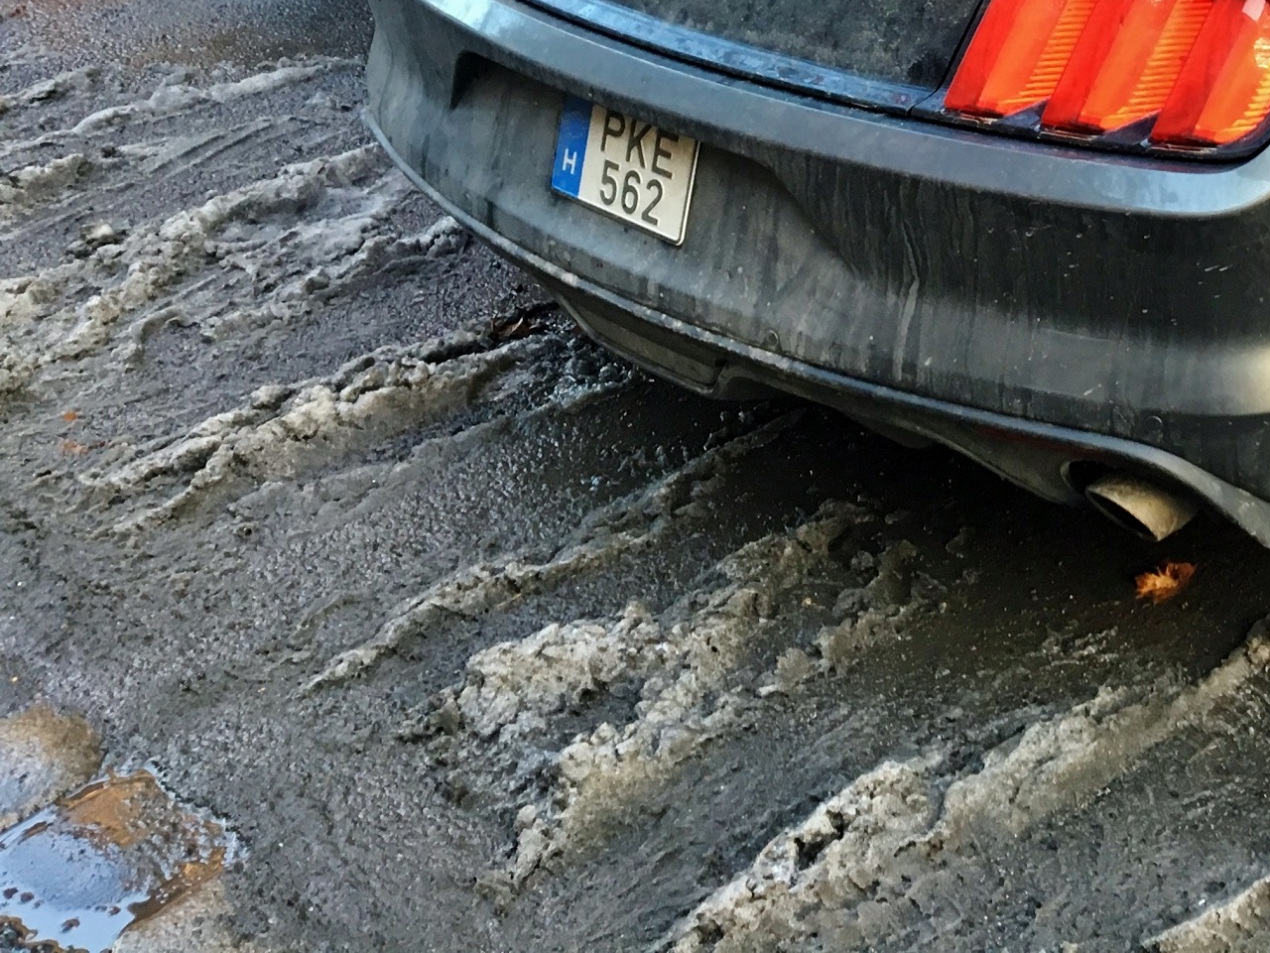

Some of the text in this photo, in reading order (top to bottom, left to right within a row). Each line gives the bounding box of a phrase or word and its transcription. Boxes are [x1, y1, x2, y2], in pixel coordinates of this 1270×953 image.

[600, 109, 680, 180] PKE
[562, 148, 664, 226] H 562
